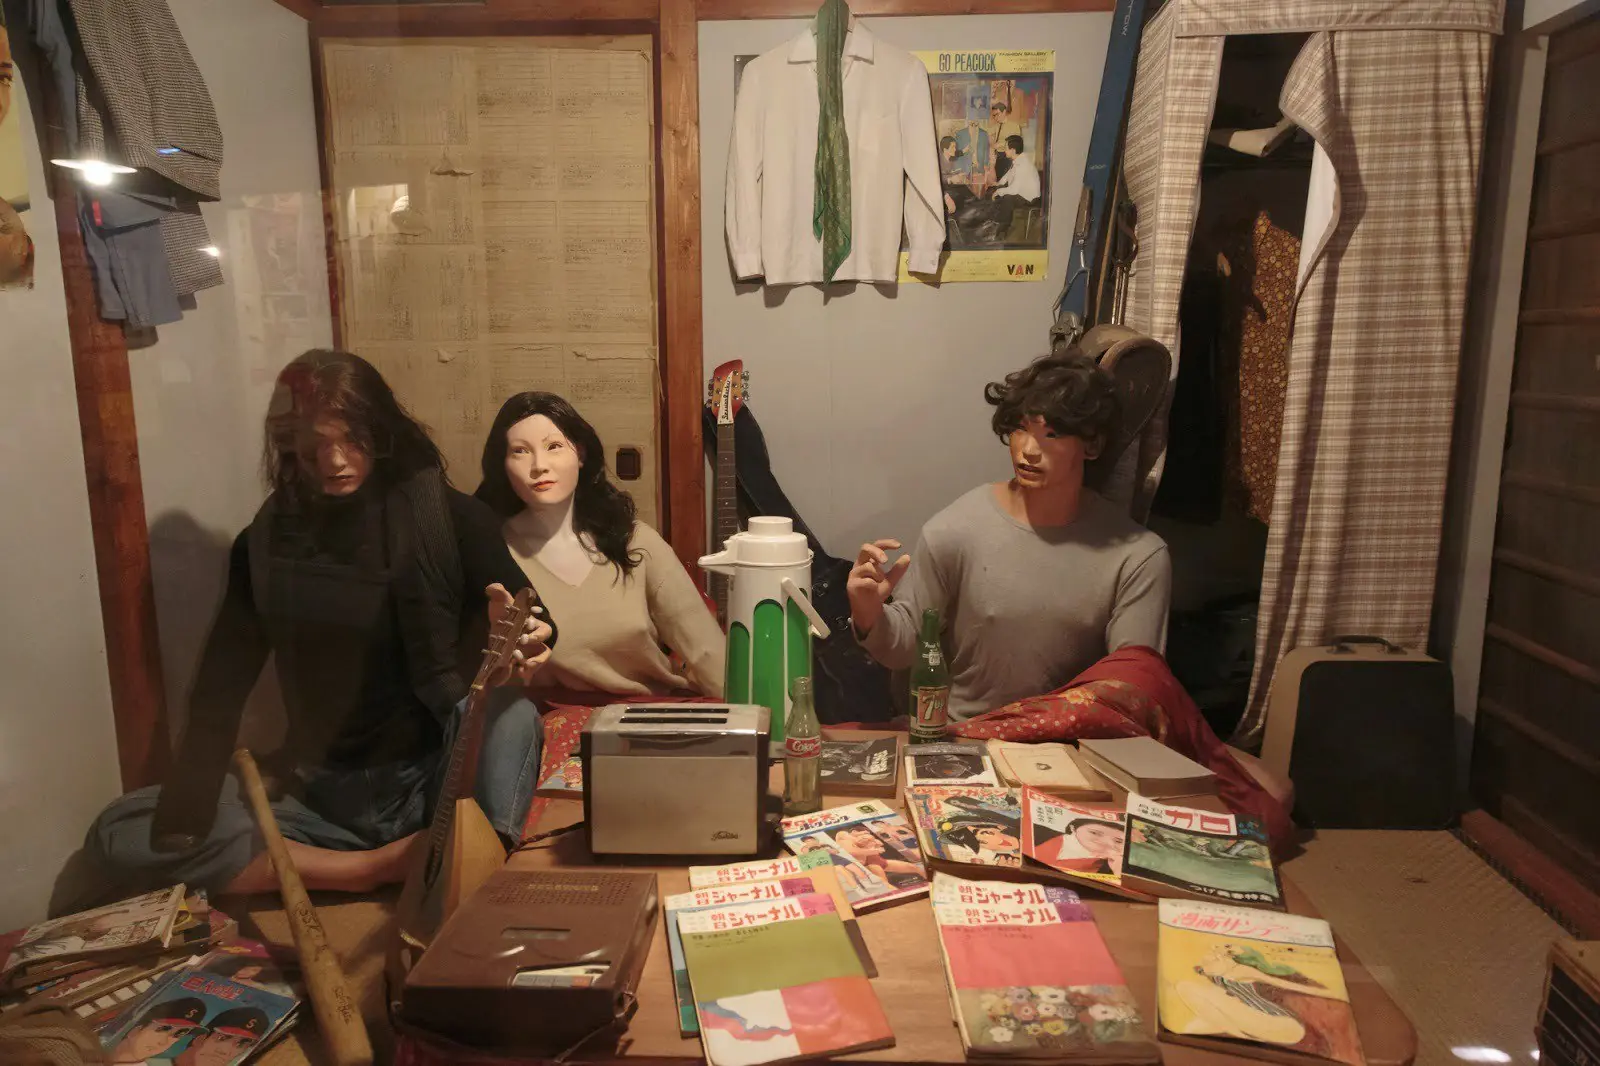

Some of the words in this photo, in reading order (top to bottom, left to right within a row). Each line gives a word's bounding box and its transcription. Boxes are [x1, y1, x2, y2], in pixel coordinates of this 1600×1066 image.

[938, 53, 951, 72] GO
[954, 53, 997, 72] PEACOCK
[1006, 264, 1034, 275] VAN
[792, 740, 817, 753] Coke
[717, 861, 799, 882] 朝日ジャーナル
[695, 884, 781, 906] 朝日ジャーナル
[958, 885, 1045, 905] 朝日ジャーナル
[711, 904, 800, 929] 朝日ジャーナル
[965, 907, 1056, 924] 朝日ジャーナル
